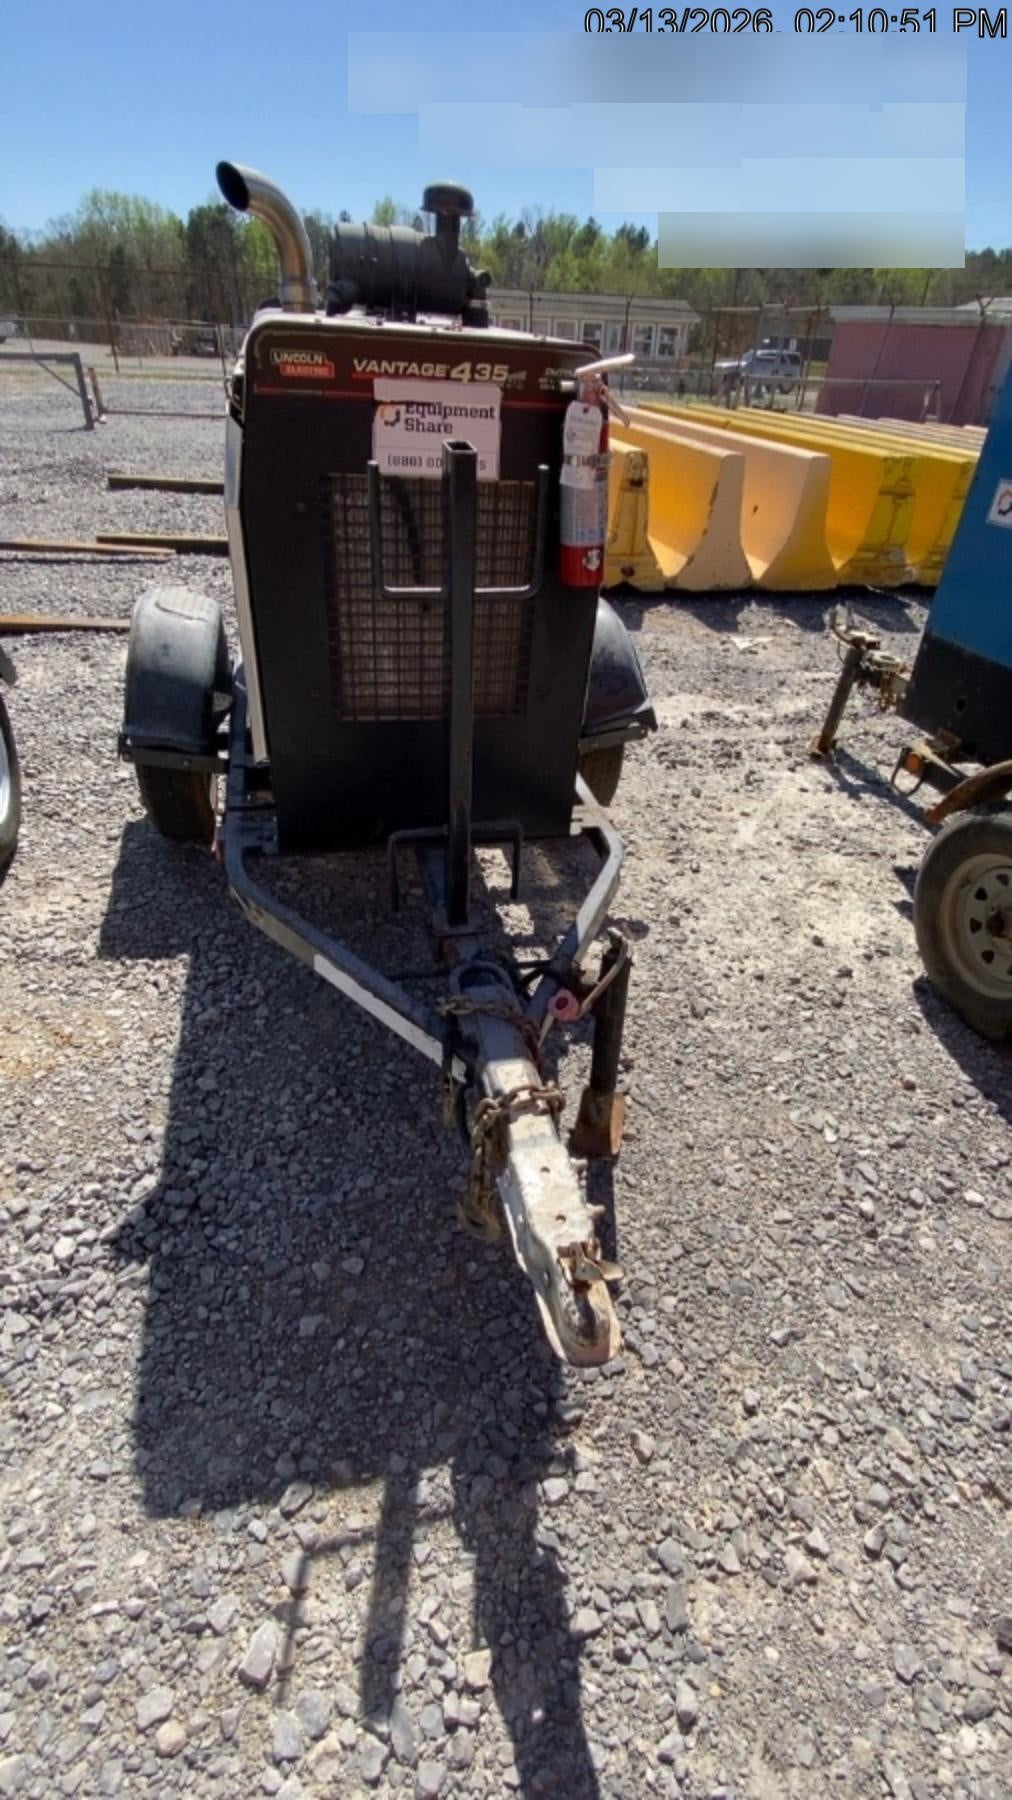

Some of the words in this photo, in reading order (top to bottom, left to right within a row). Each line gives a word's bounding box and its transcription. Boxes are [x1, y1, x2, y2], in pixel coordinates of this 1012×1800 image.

[274, 352, 322, 365] LINCOLN
[353, 358, 448, 378] VANTAGE
[450, 361, 510, 383] 435
[405, 403, 496, 419] Equipment
[405, 418, 453, 434] Share
